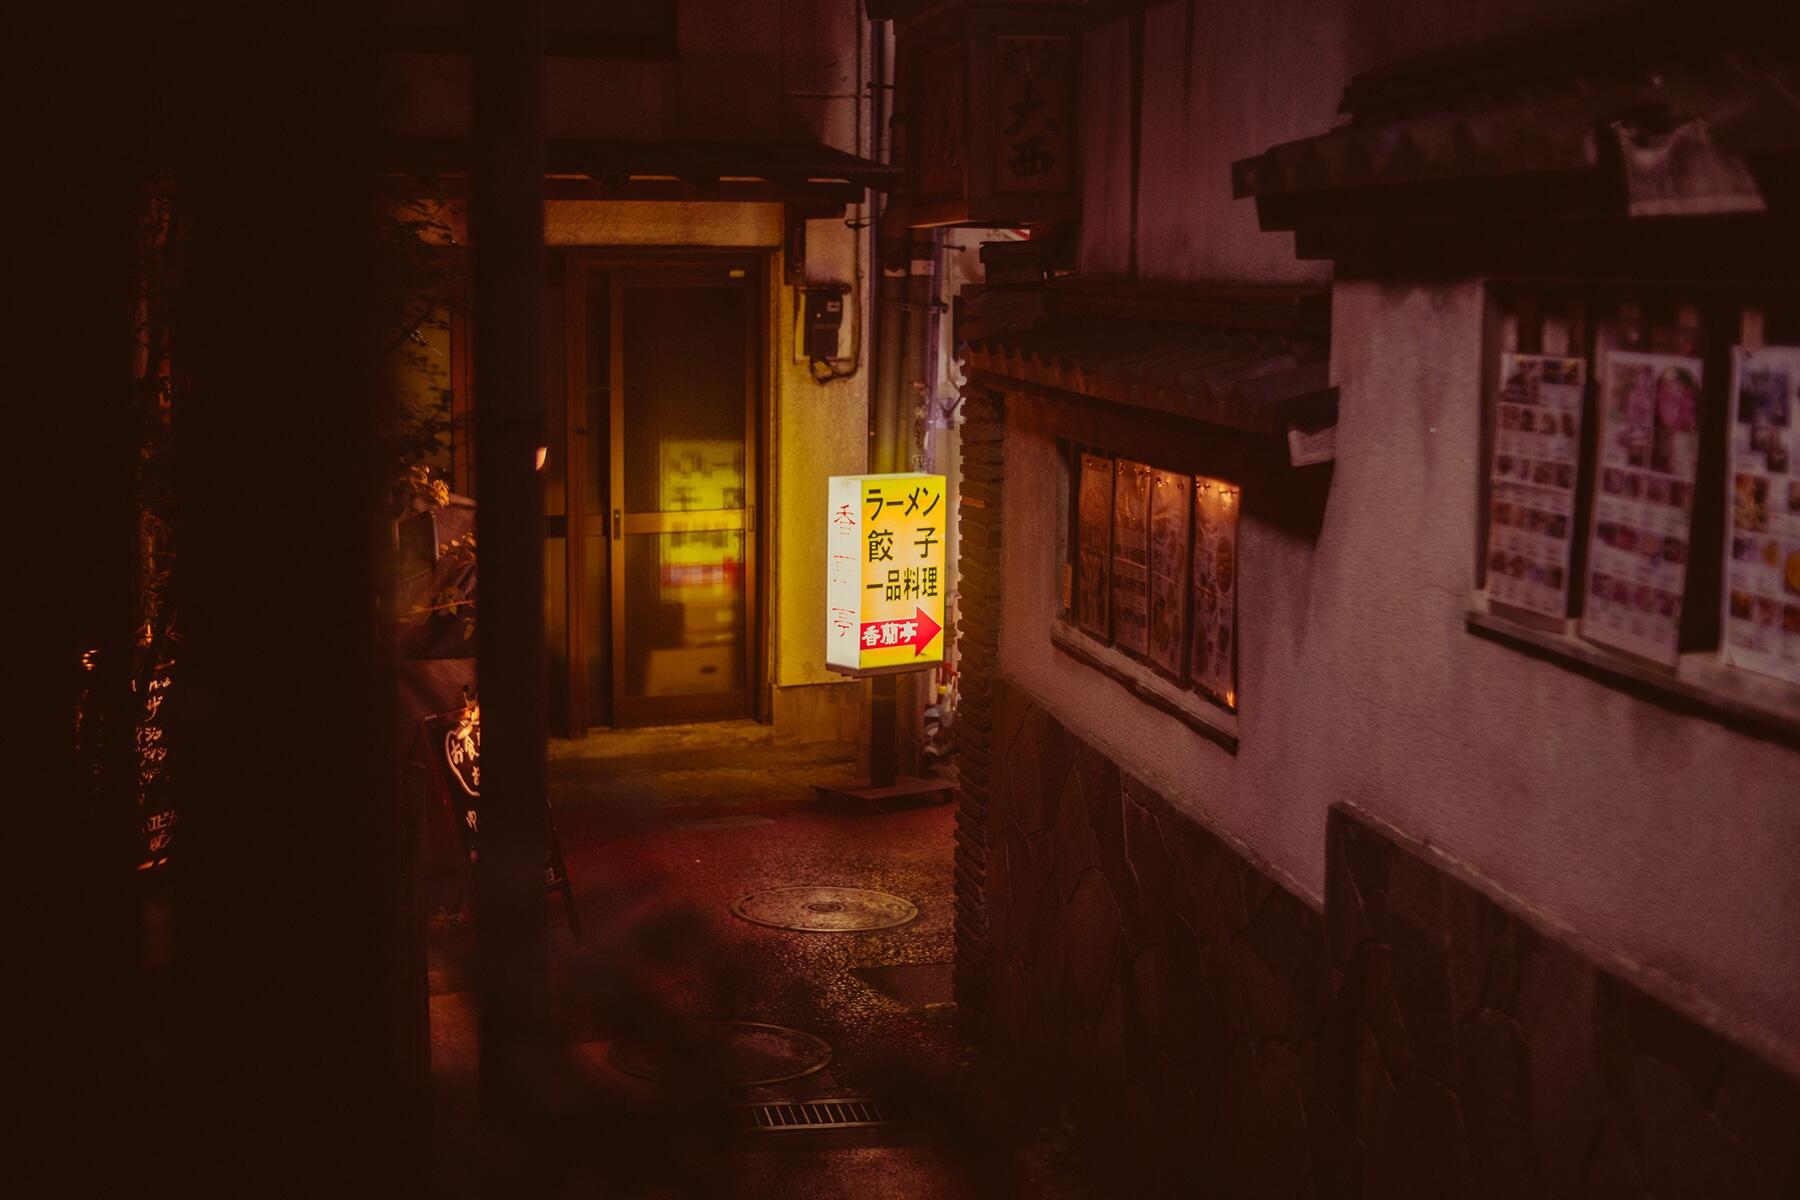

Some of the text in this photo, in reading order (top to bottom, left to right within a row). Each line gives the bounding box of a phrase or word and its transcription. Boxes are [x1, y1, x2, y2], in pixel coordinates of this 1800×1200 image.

[866, 486, 940, 522] ラーメン
[867, 527, 938, 562] 餃子
[831, 504, 856, 638] 香亭
[866, 567, 938, 601] 一品料理
[861, 621, 920, 647] 香蘭亭
